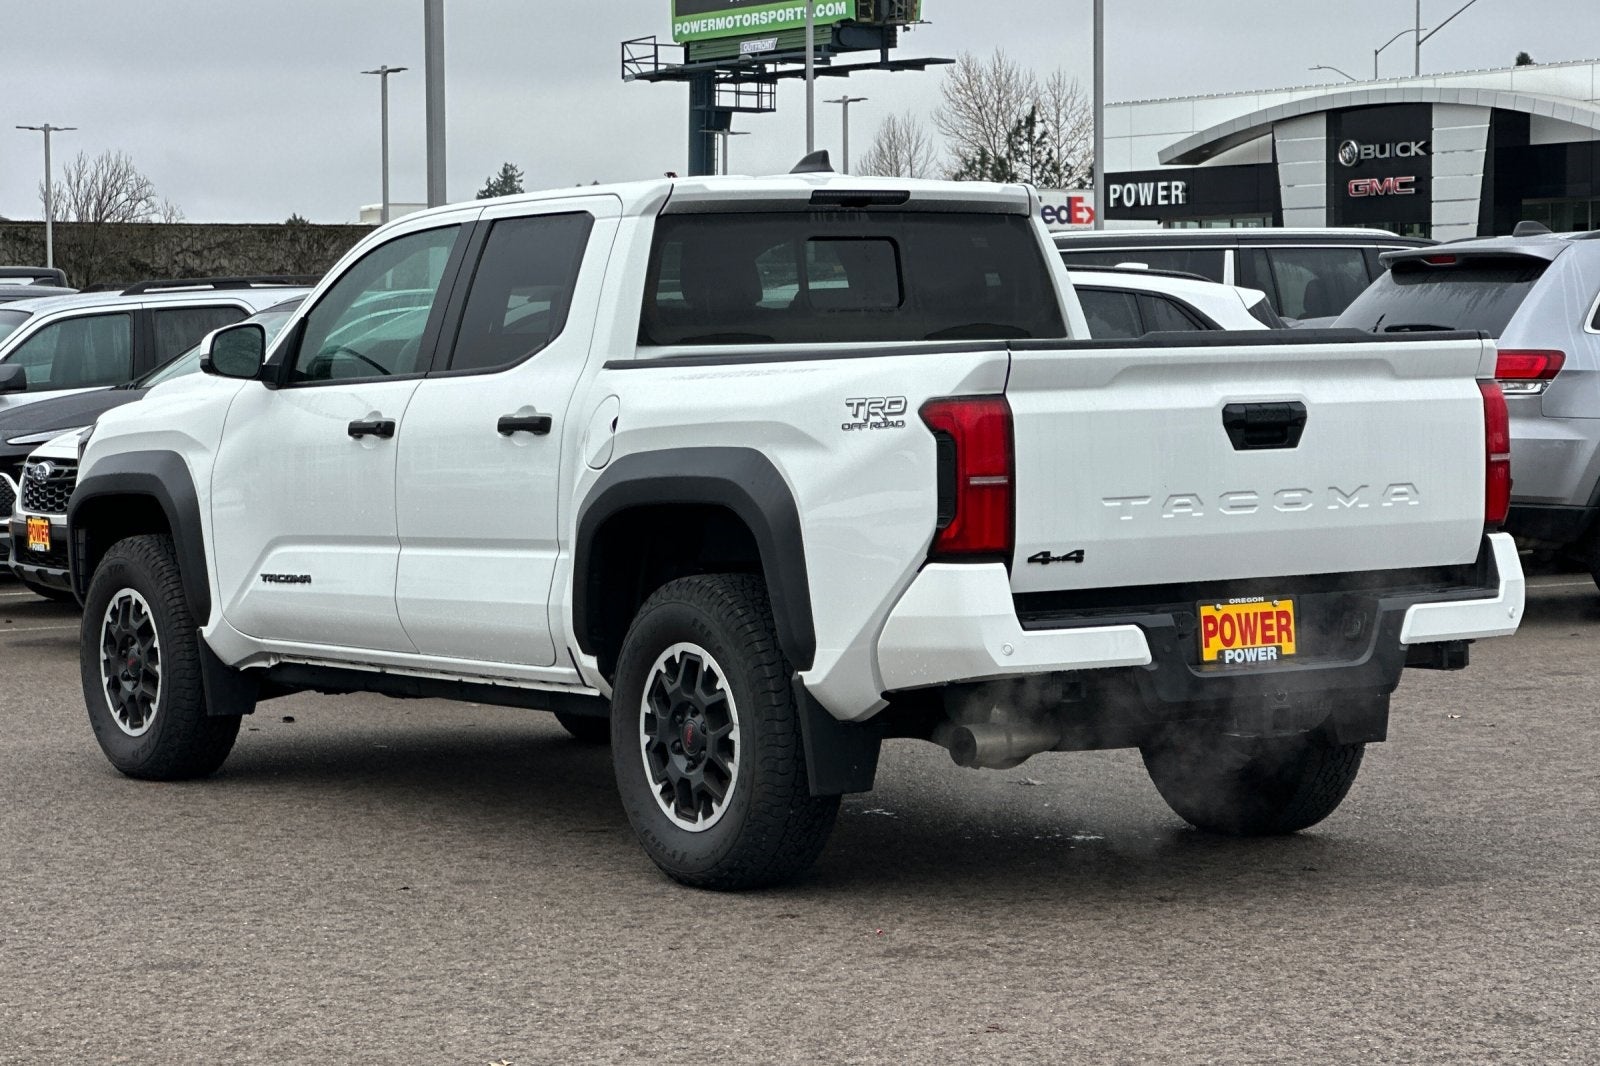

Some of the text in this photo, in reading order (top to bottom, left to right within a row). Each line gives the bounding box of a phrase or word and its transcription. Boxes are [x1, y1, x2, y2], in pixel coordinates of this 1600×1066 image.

[1360, 141, 1426, 160] BUICK
[1109, 181, 1185, 207] POWER
[1348, 176, 1415, 197] GMC
[845, 396, 907, 422] TRD
[1102, 483, 1420, 520] TACOMA
[261, 574, 311, 583] TACOMA
[1203, 610, 1293, 648] POWER
[1225, 646, 1277, 663] POWER
